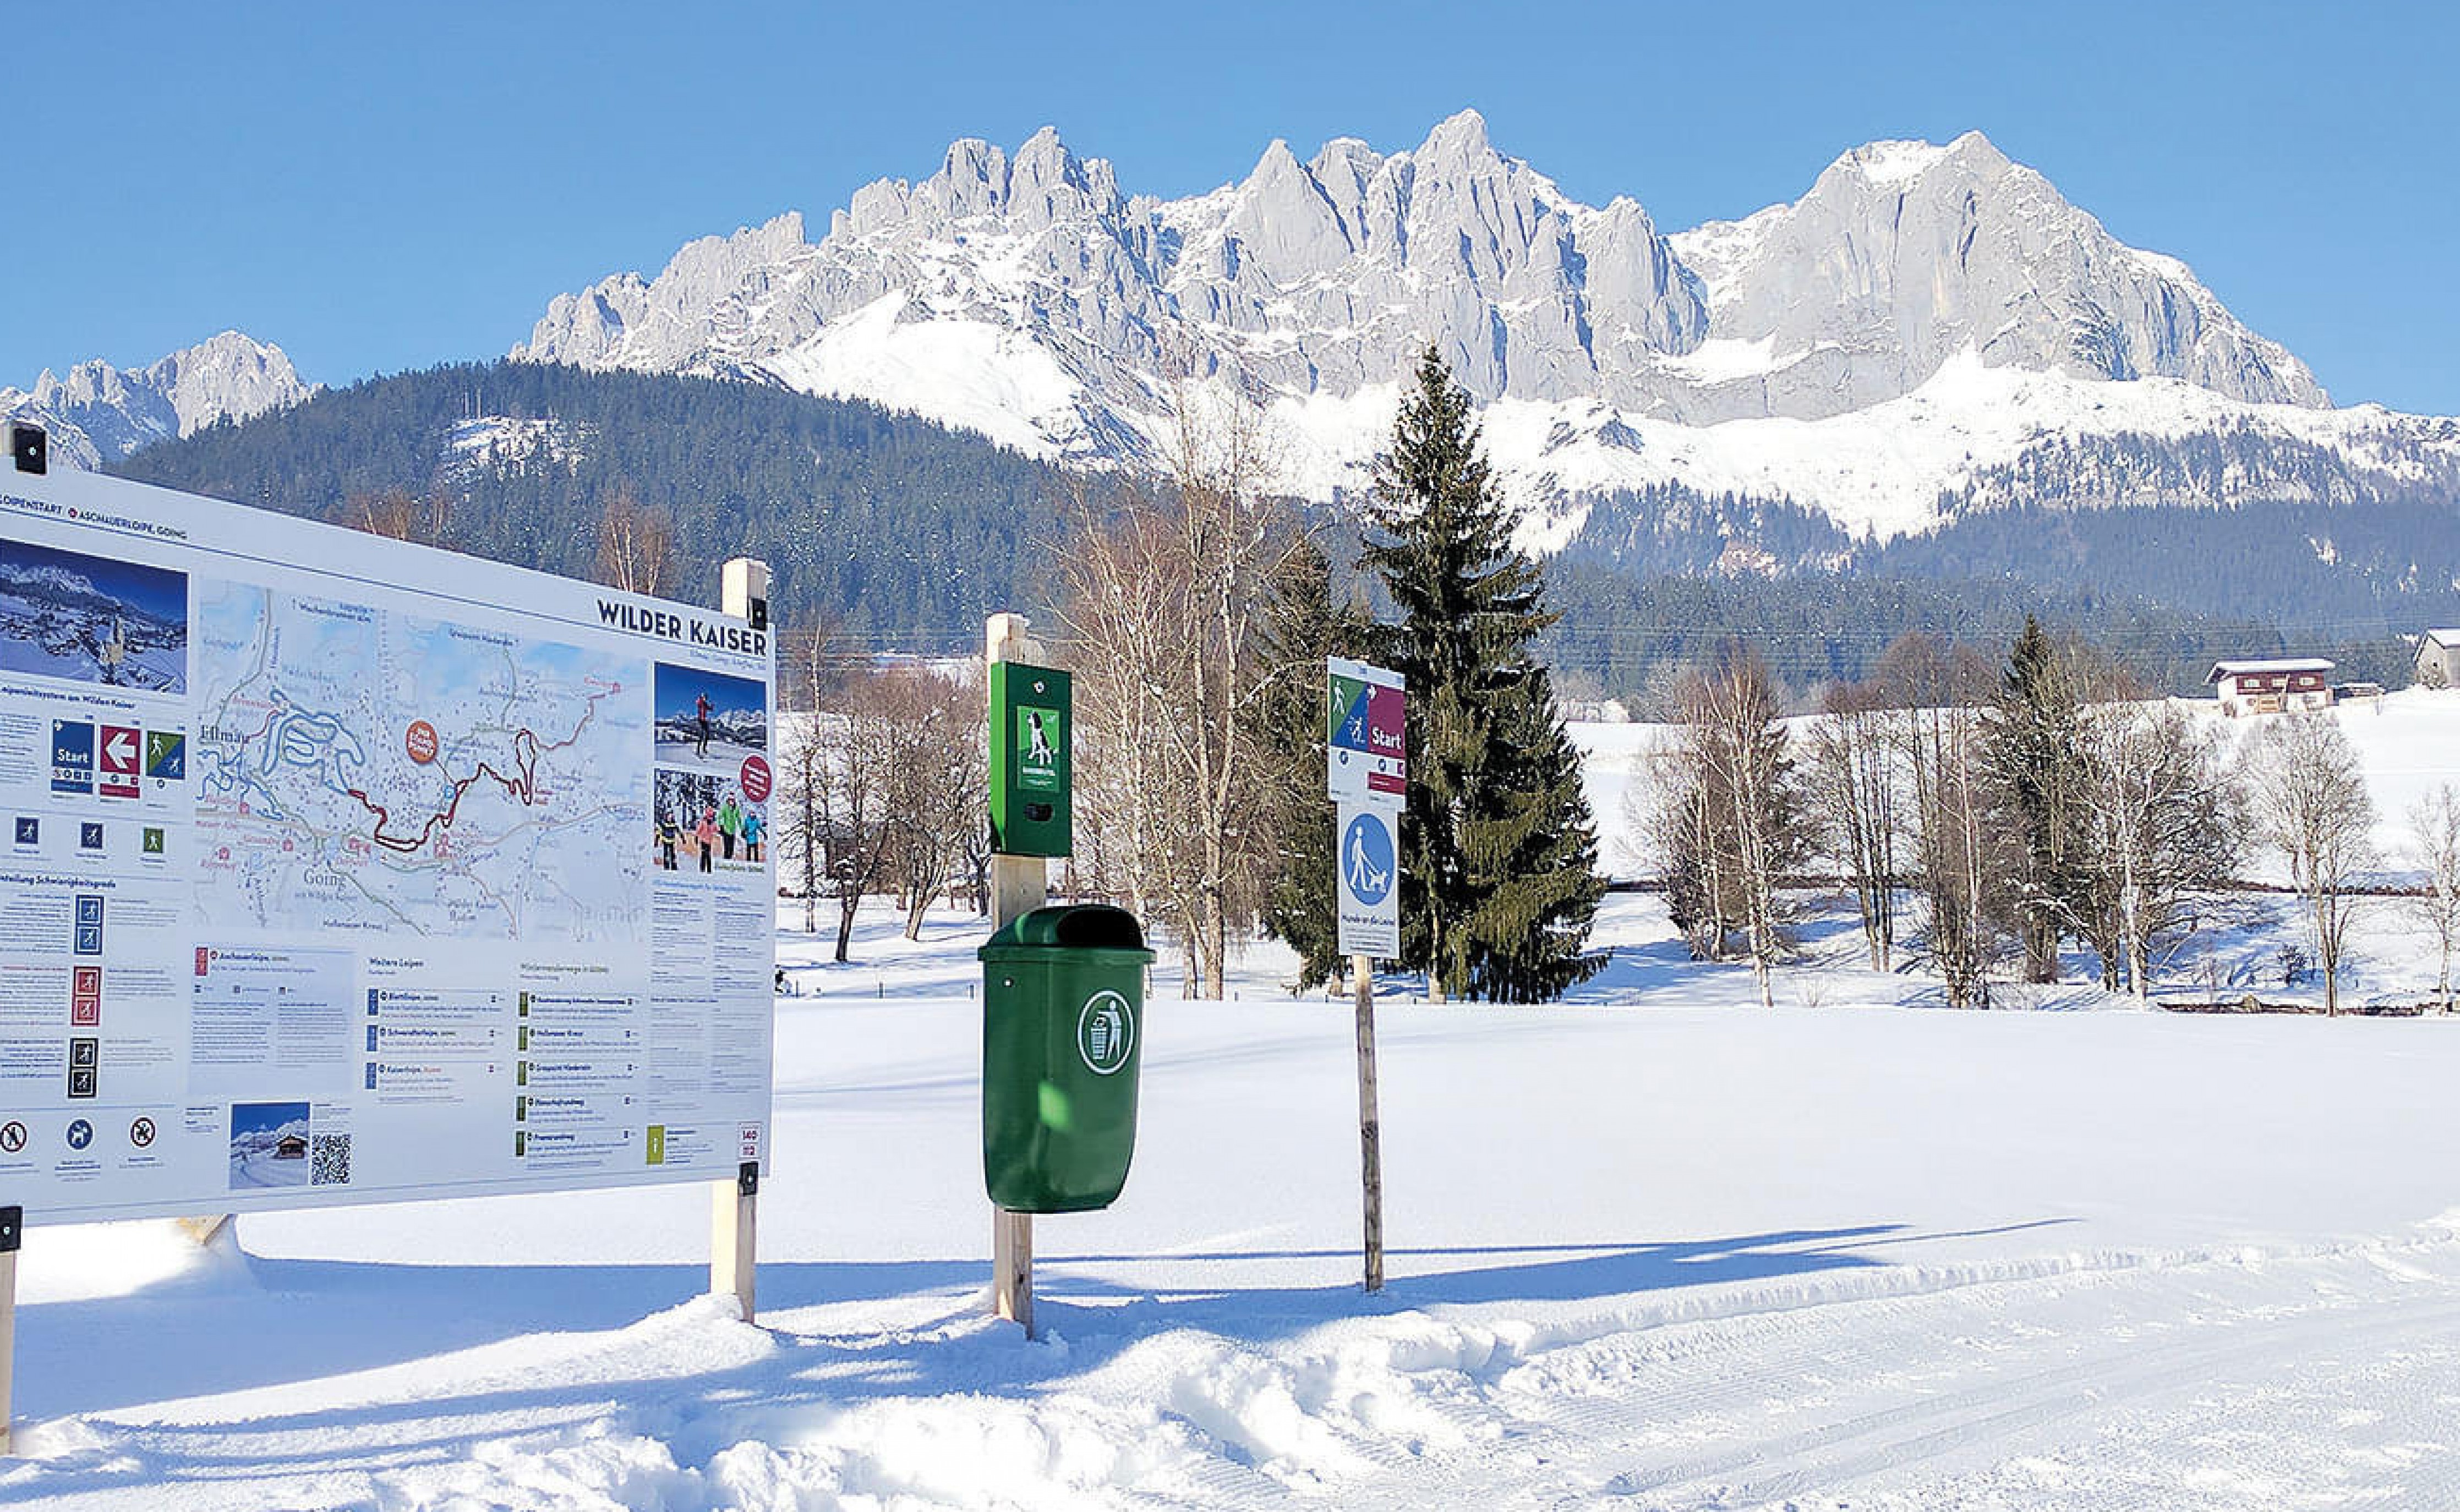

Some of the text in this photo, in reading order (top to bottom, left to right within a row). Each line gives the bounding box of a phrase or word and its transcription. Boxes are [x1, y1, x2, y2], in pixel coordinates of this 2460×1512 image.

[598, 598, 767, 655] WILDER KAISER
[1372, 726, 1402, 750] Start
[57, 748, 89, 764] Start
[304, 868, 346, 891] Going
